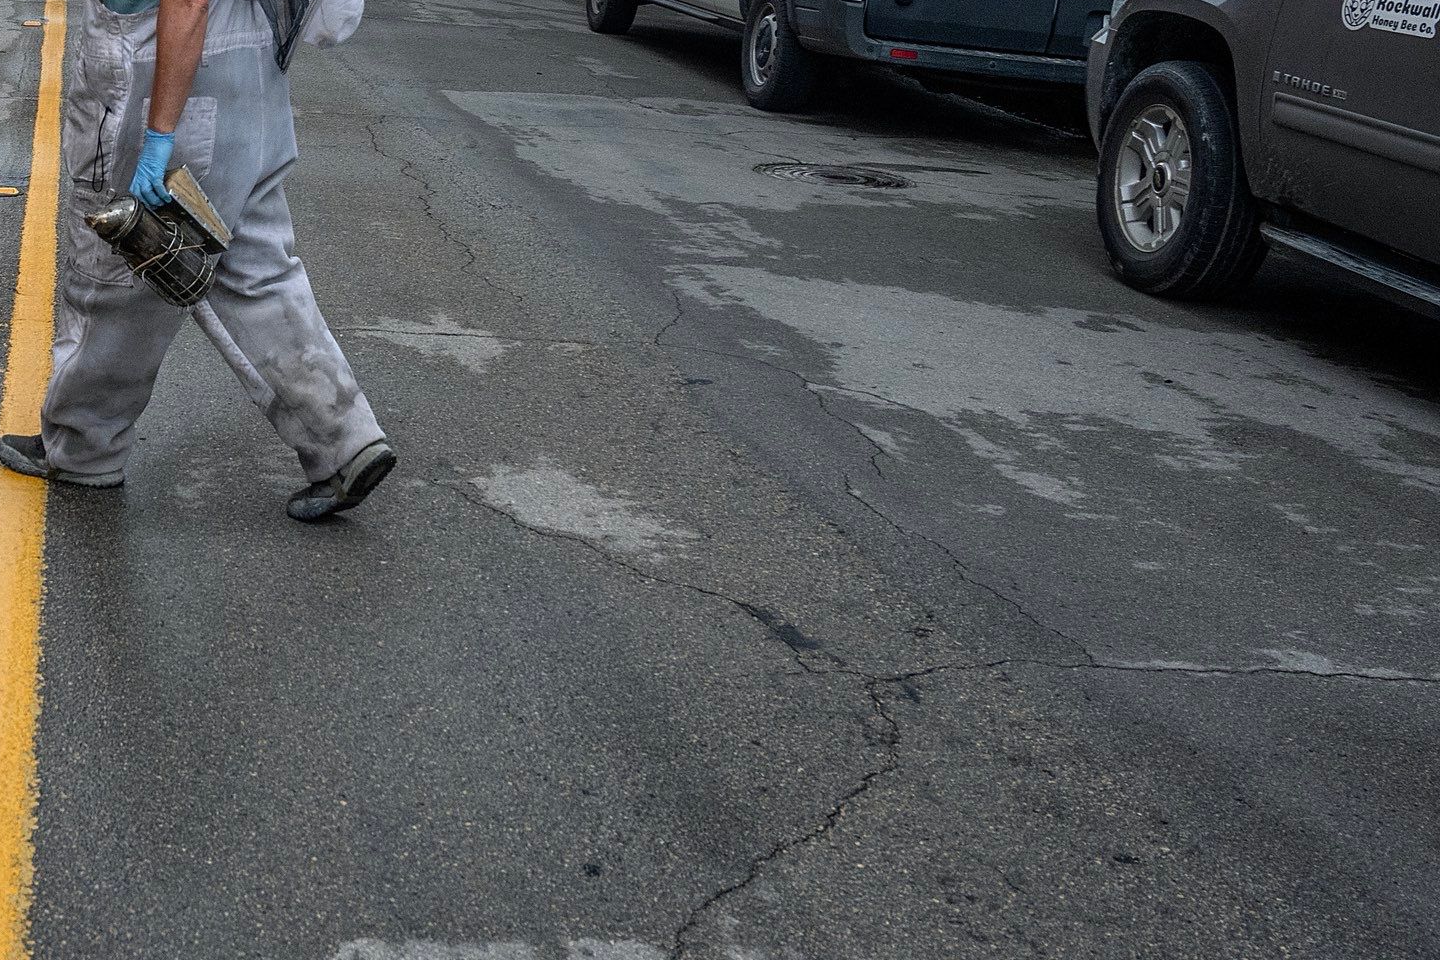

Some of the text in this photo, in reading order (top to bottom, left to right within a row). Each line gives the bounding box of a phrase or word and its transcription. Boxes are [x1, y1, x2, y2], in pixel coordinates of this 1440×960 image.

[1372, 15, 1434, 35] Honey Bee Co.
[1284, 73, 1331, 96] TAHOE
